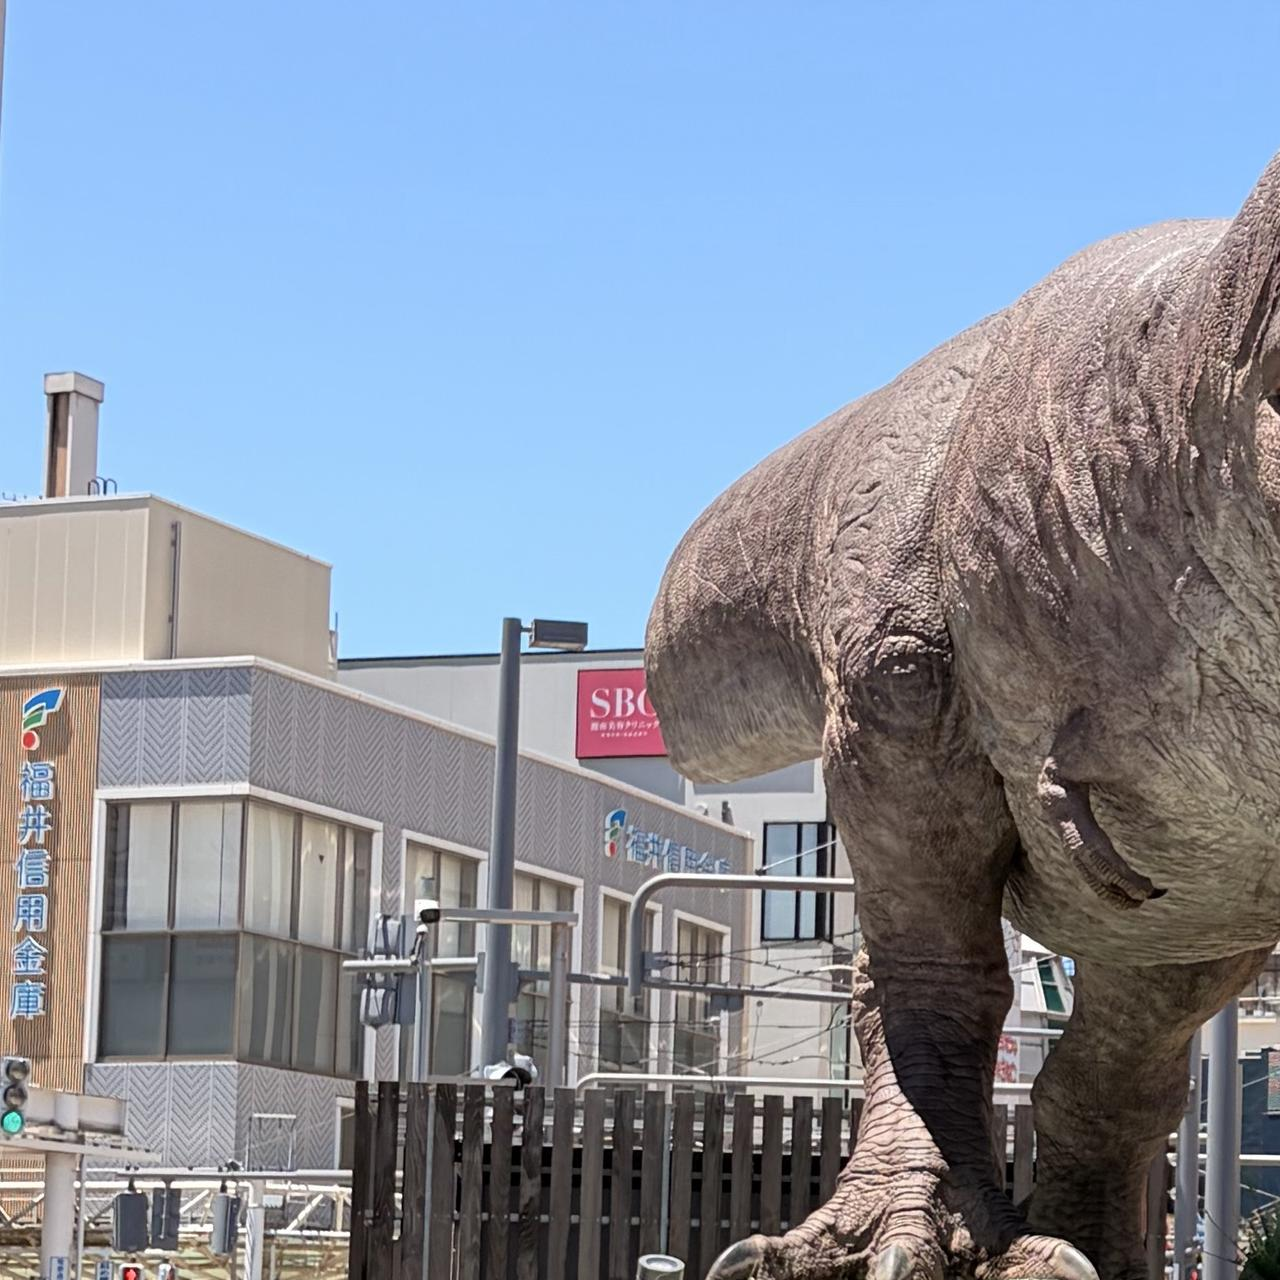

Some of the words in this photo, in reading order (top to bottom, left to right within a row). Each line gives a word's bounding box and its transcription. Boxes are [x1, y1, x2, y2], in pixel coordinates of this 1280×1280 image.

[9, 761, 55, 1020] 福井信用金庫
